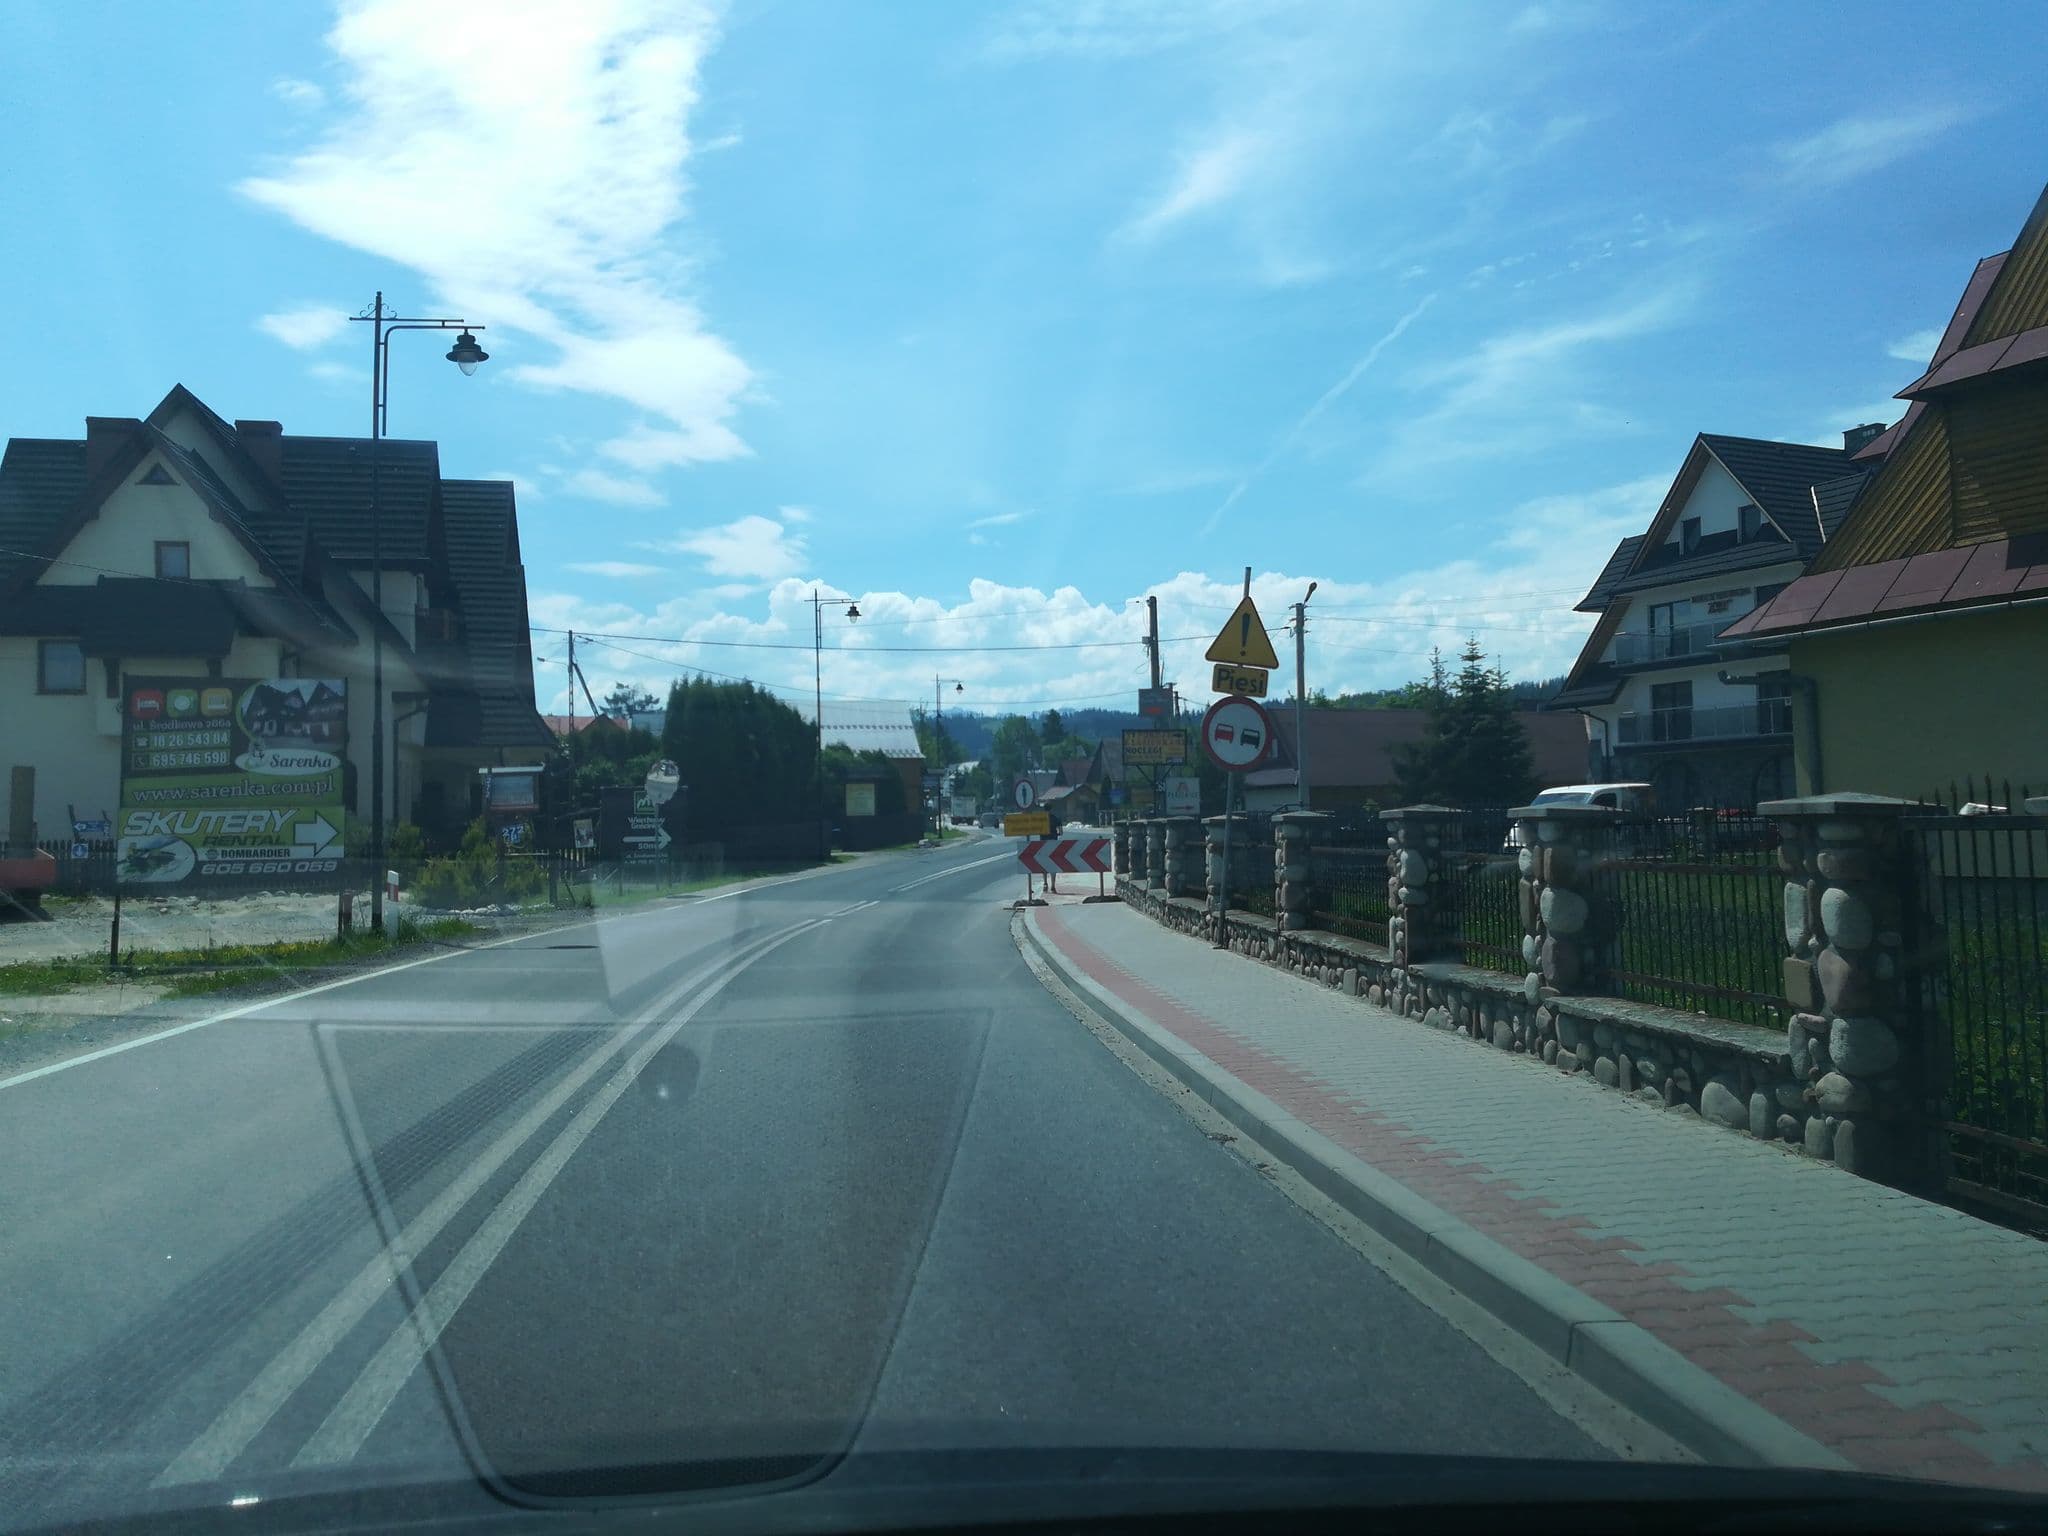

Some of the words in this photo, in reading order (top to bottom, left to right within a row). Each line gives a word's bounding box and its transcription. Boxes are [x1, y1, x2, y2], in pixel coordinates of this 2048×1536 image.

[1217, 668, 1265, 694] Piesi
[168, 734, 184, 747] 26
[187, 732, 210, 746] 543
[152, 753, 176, 767] 695
[270, 756, 332, 770] Sarenka
[133, 775, 335, 802] www.sarenka.com.pl
[124, 810, 297, 835] SKUTERY
[202, 835, 285, 847] RENTAL
[221, 849, 291, 859] BOMBARDIER
